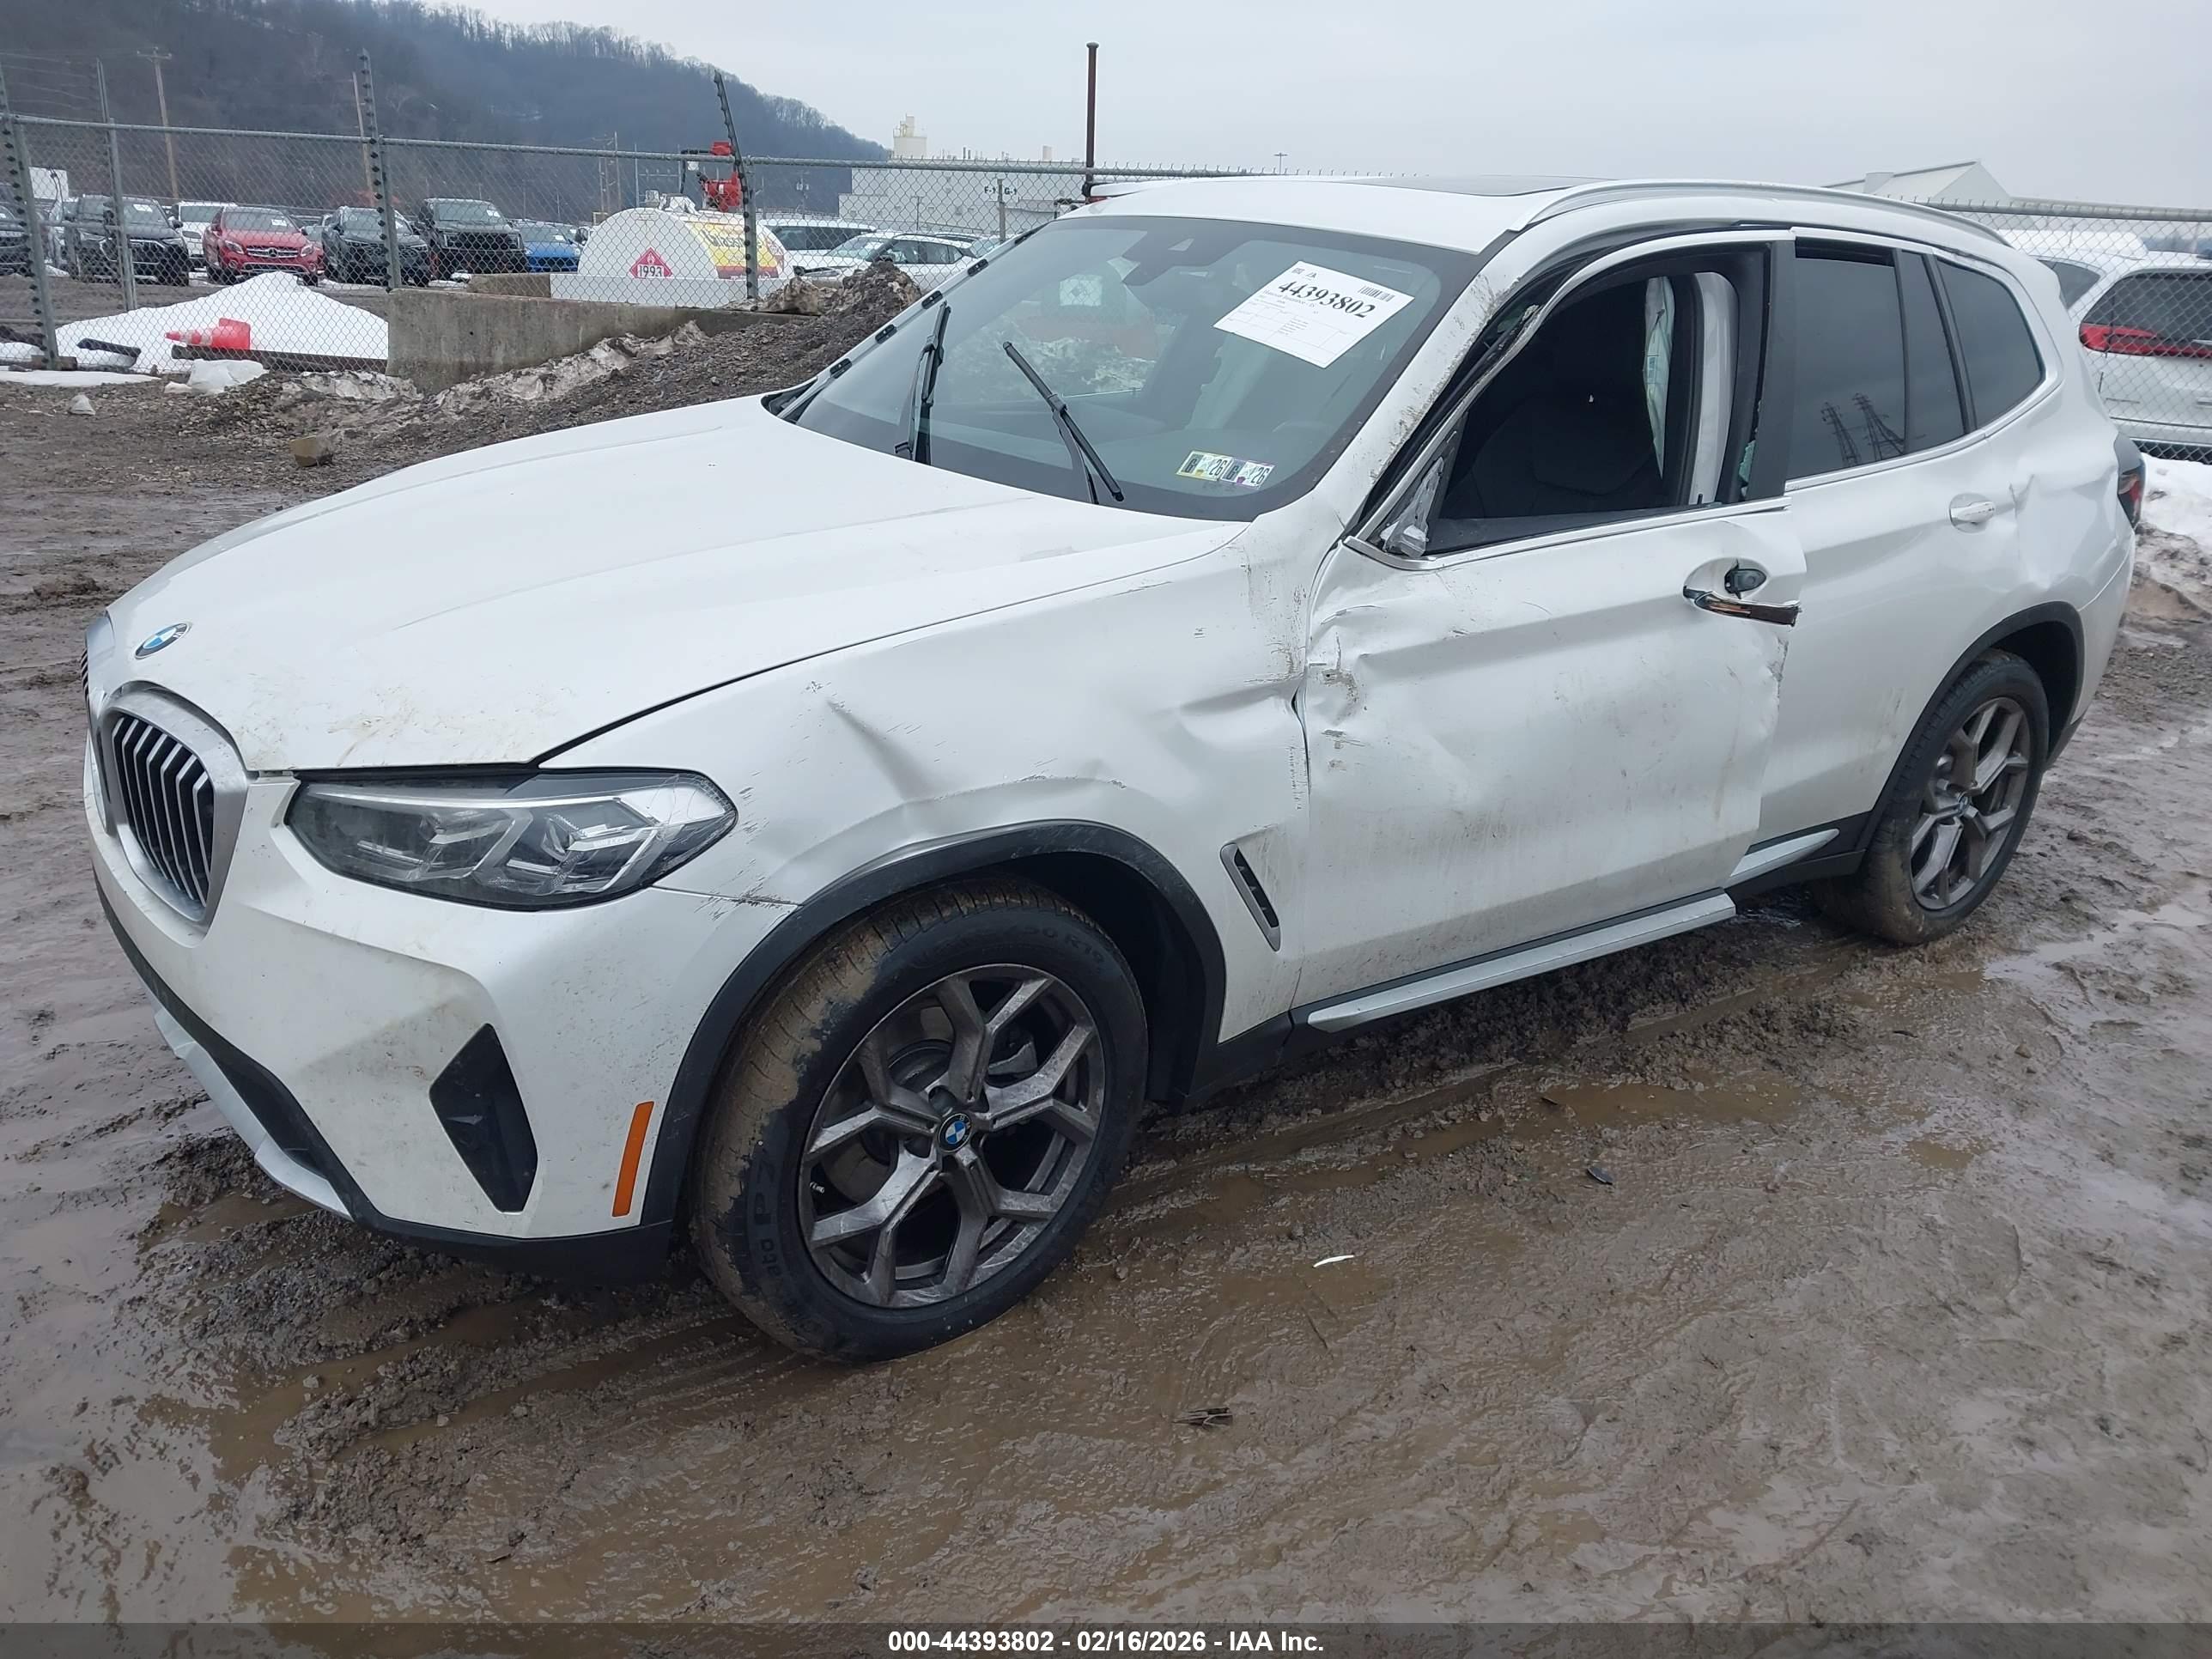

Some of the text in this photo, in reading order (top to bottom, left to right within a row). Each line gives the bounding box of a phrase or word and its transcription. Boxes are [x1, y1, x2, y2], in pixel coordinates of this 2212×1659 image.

[639, 265, 662, 277] 1993
[1278, 281, 1376, 319] 44393802
[1209, 459, 1228, 477] 26
[1250, 466, 1270, 484] 26
